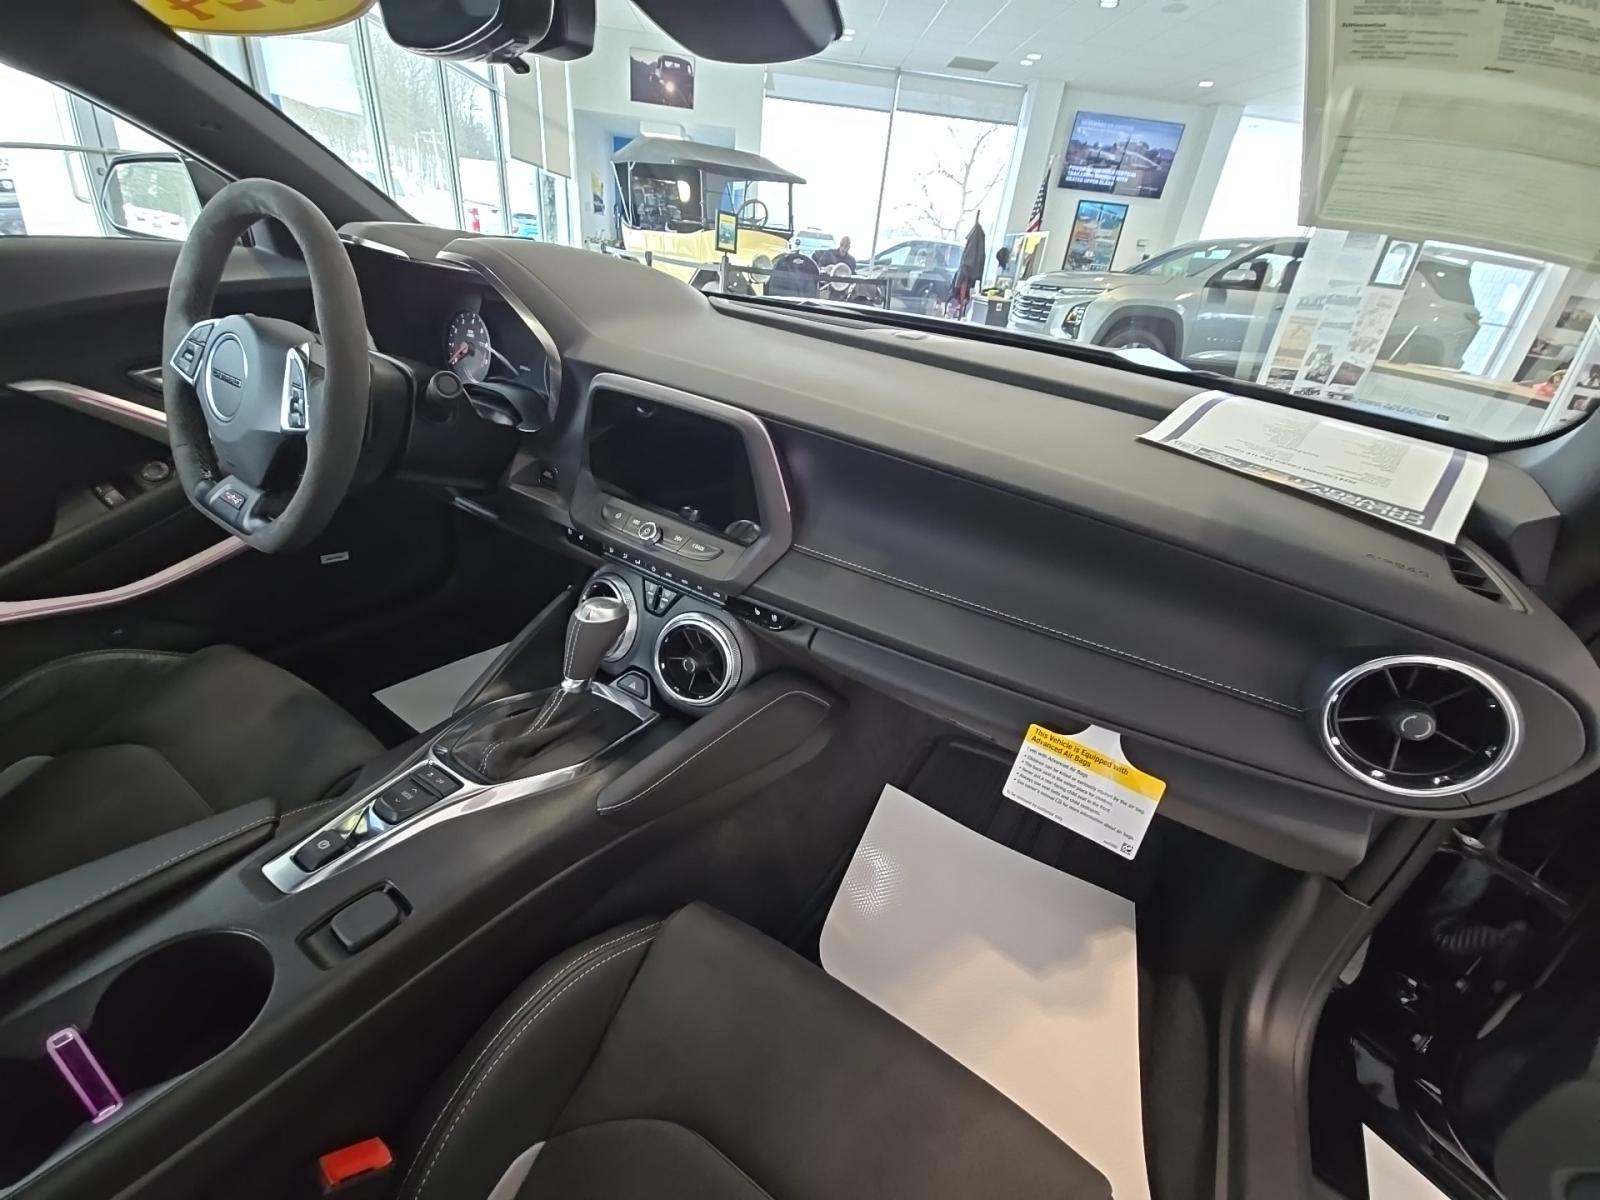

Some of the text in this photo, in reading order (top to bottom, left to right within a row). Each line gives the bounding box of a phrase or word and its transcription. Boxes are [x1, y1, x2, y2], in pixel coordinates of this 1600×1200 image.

[1031, 736, 1092, 768] Advanced Air Bags
[1035, 728, 1129, 775] This Vehicle is Equipped with
[1048, 756, 1070, 769] Advanced
